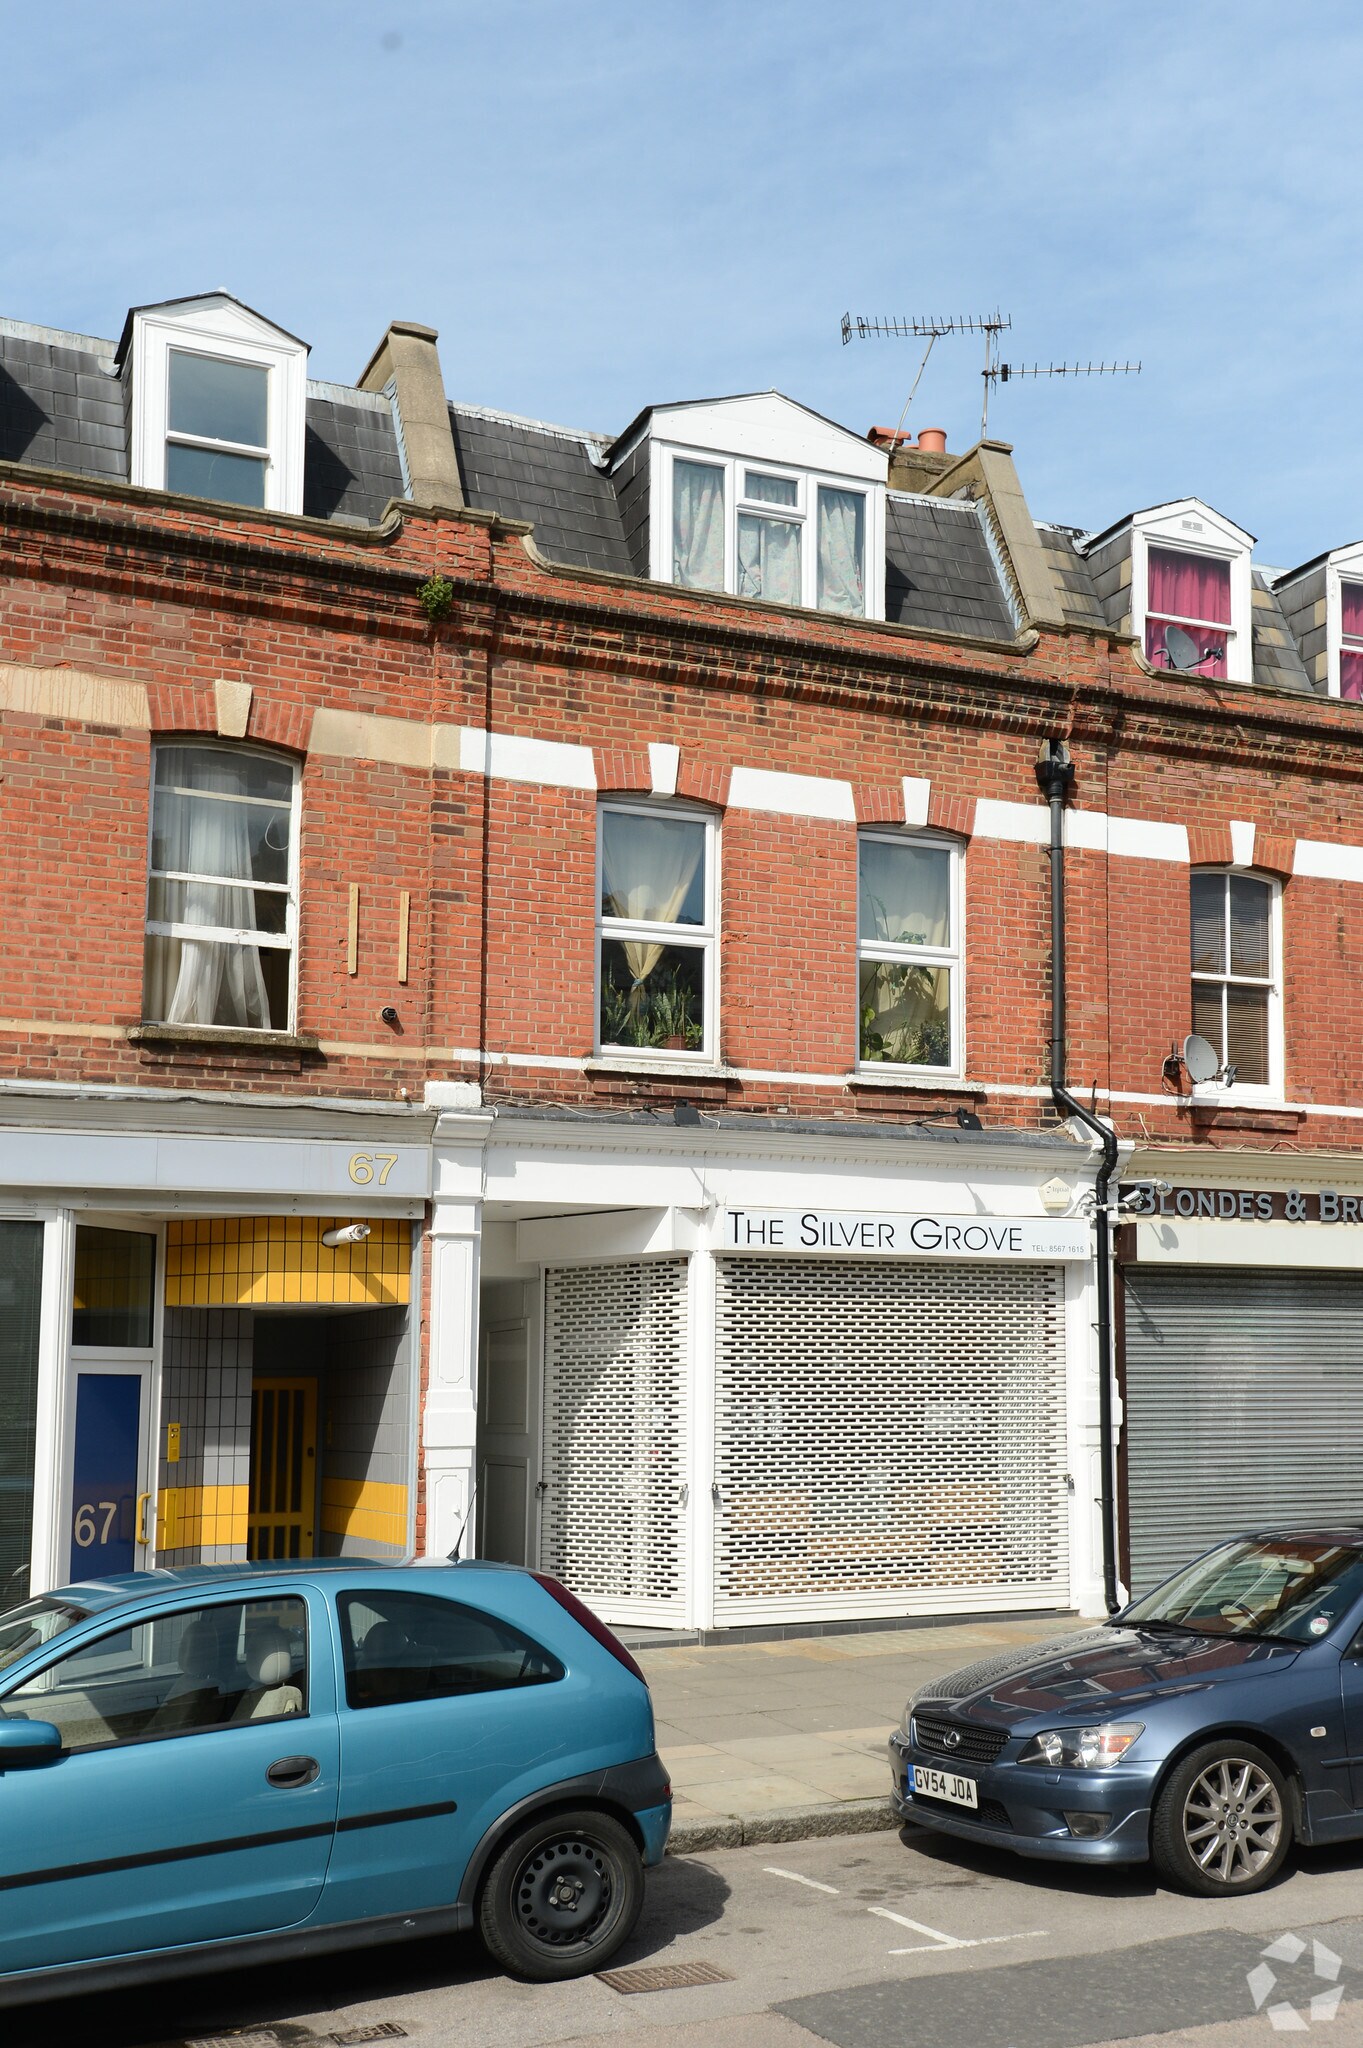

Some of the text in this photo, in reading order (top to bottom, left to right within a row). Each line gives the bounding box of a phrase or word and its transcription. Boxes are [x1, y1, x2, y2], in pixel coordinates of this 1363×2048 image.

[347, 1152, 399, 1186] 67
[1134, 1182, 1363, 1222] BLONDES & BR
[727, 1211, 1022, 1251] THE SILVER GROVE
[1031, 1244, 1048, 1253] TEL:
[1048, 1245, 1066, 1253] 8567
[74, 1502, 117, 1547] 67
[914, 1768, 974, 1803] GV54 JOA
